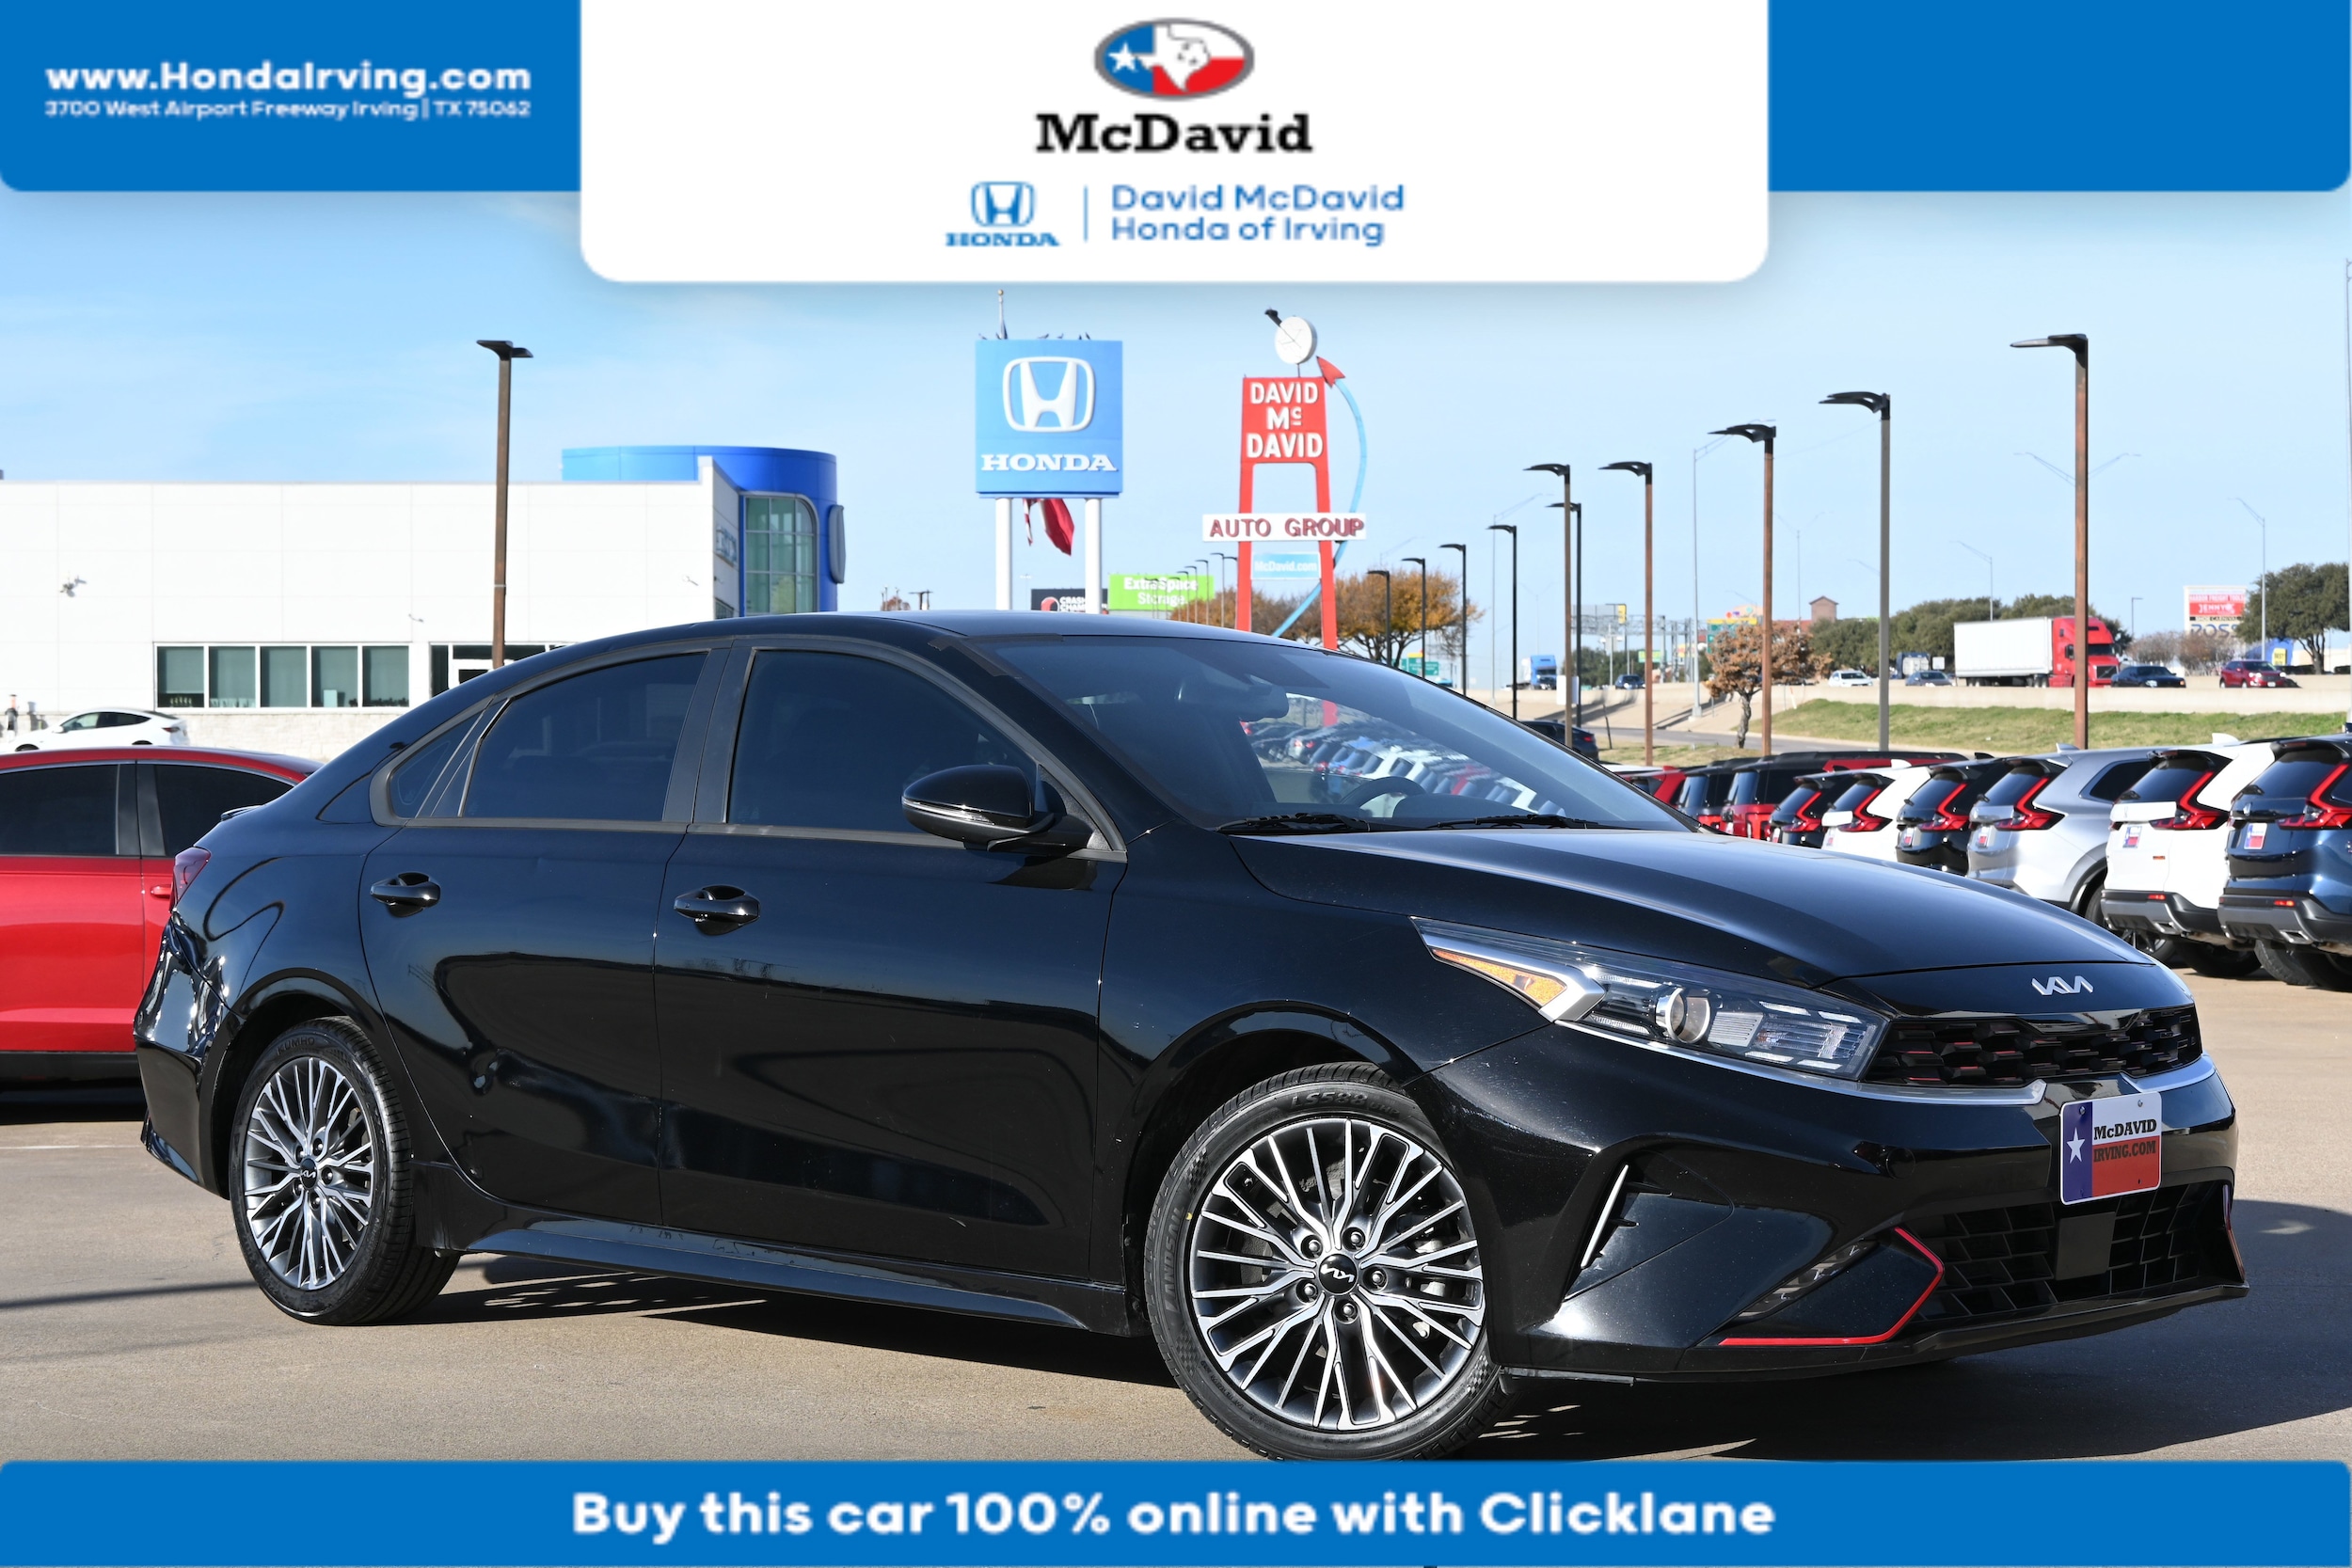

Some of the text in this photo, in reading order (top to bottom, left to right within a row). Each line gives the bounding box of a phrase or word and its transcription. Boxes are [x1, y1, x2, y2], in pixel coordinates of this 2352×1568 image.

[1250, 381, 1319, 404] DAVID
[1247, 433, 1324, 458] DAVID
[980, 452, 1118, 472] HONDA
[1209, 517, 1364, 537] AUTO GROUP
[1254, 560, 1317, 572] McDavid.com
[1123, 577, 1198, 594] Extra Space
[2093, 1118, 2157, 1140] McDAVID
[2093, 1140, 2157, 1163] IRVING.COM
